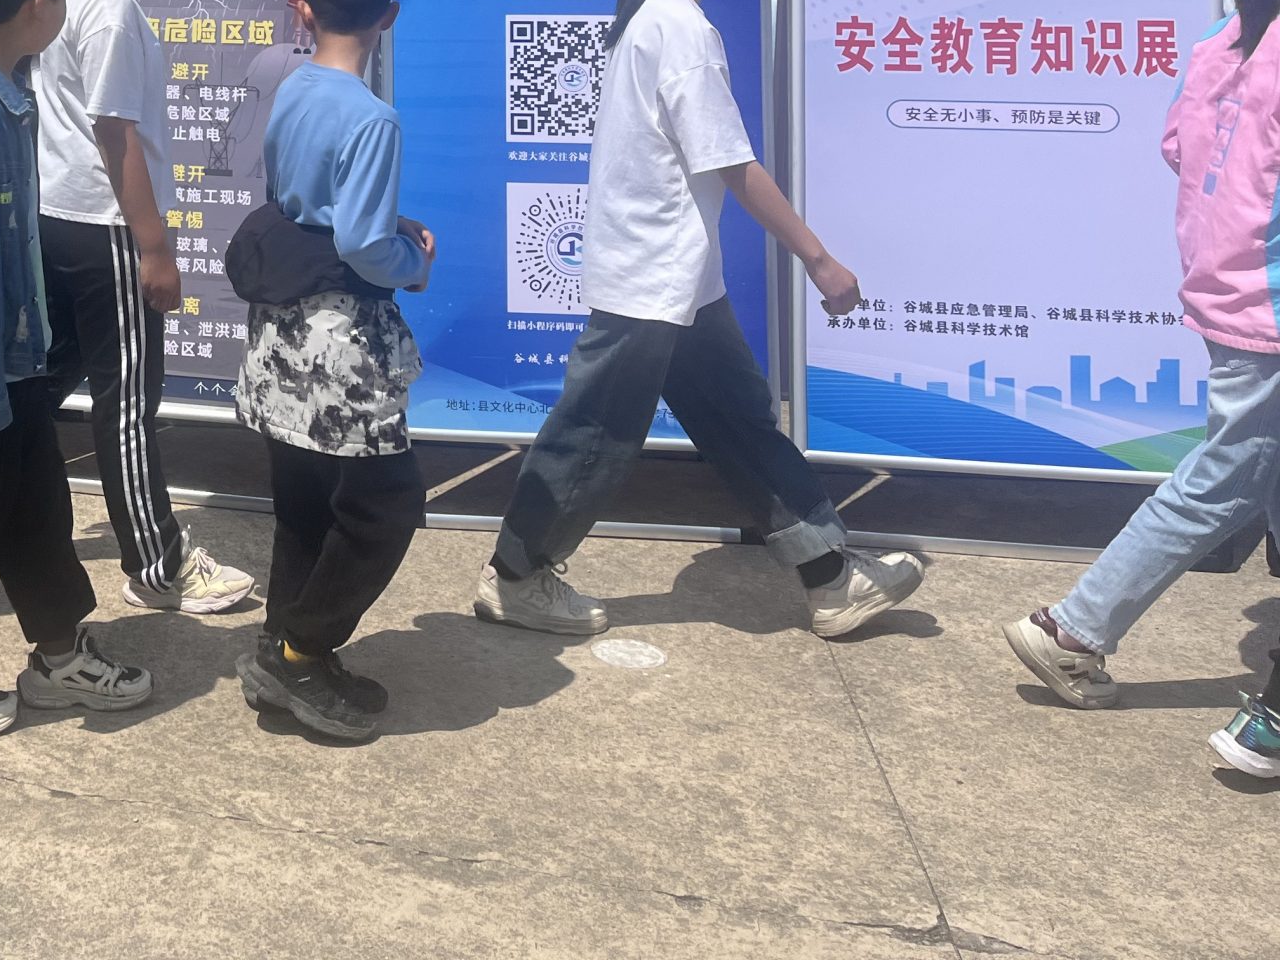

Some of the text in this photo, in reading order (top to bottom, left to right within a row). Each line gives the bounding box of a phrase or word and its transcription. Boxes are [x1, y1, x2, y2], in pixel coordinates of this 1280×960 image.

[834, 16, 1180, 78] 安全教育知识展
[171, 62, 209, 81] 避开
[166, 84, 248, 103] 器、电线杆
[166, 104, 231, 122] 危险区域
[905, 106, 1102, 127] 安全无小事、预防是关键
[168, 125, 222, 143] 止触电
[508, 150, 592, 162] 欢迎大家关注谷城
[166, 210, 204, 230] 警惕
[176, 236, 232, 254] 玻璃、
[164, 318, 249, 341] 道、泄洪道
[507, 320, 588, 333] 扫描小程序码即可
